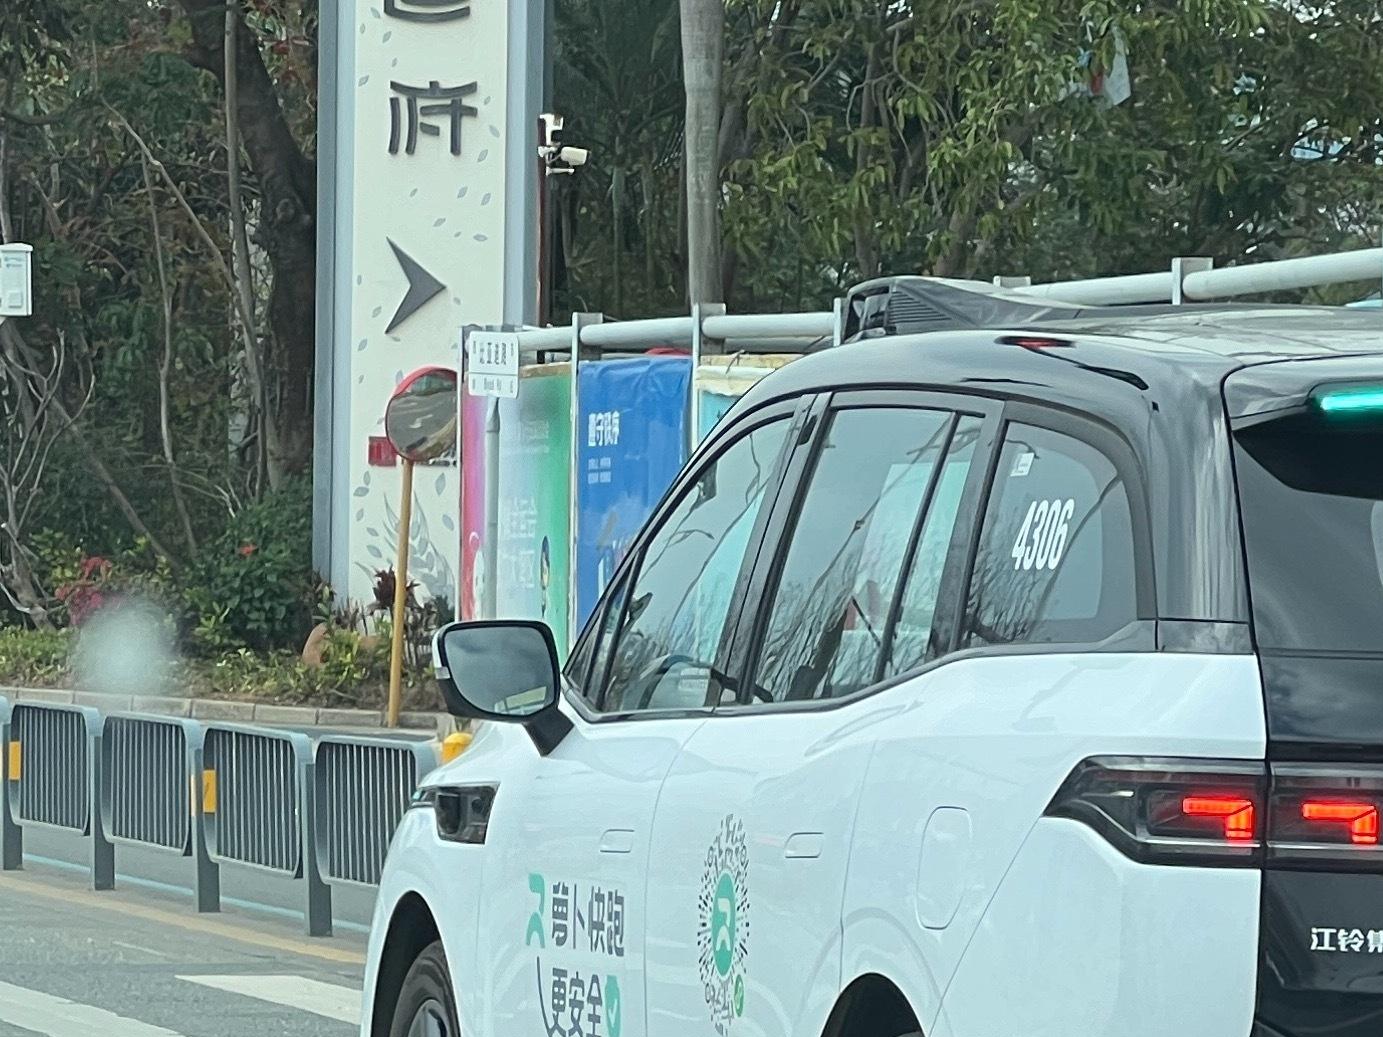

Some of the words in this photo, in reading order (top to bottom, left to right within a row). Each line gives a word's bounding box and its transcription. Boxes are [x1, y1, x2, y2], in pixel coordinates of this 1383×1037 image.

[1012, 499, 1074, 570] 4306
[551, 881, 624, 957] 萝卜快跑
